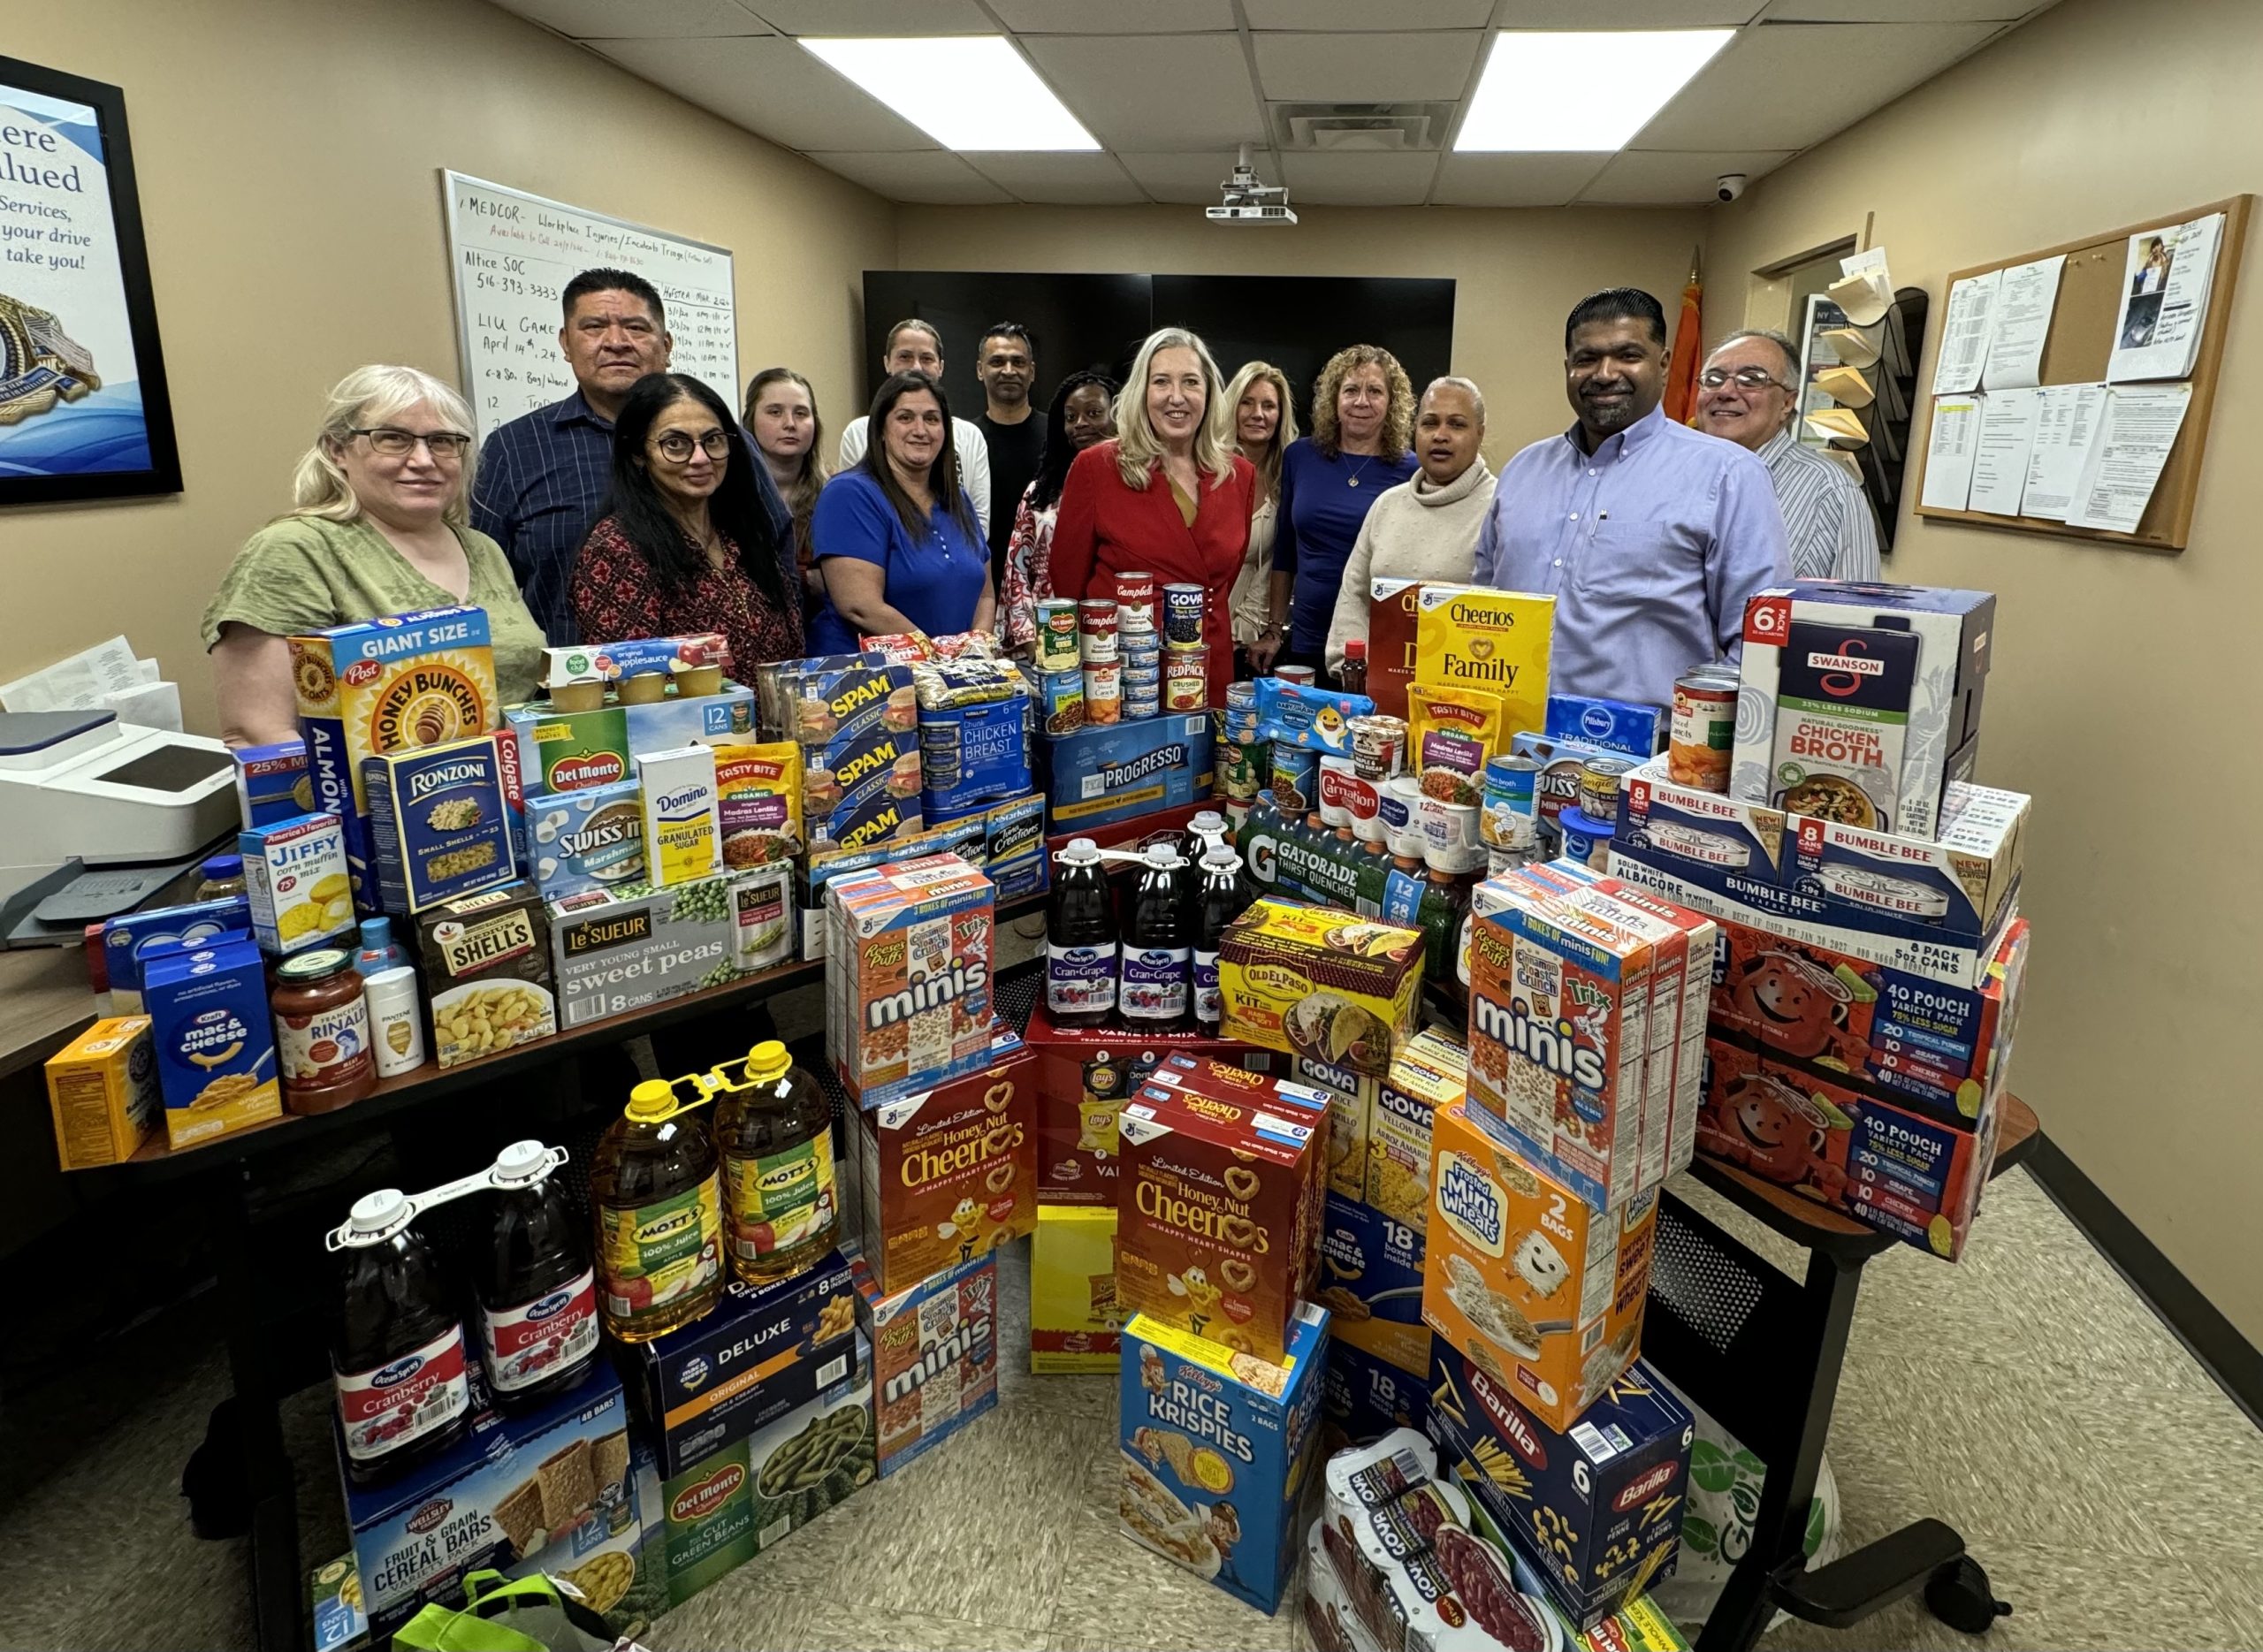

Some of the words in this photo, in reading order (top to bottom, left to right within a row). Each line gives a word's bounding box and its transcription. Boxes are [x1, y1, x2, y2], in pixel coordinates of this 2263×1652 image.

[0, 129, 57, 154] ere
[0, 153, 84, 192] lued
[2, 224, 44, 245] your
[49, 227, 92, 247] drive
[6, 247, 44, 268] take
[49, 252, 86, 270] you!
[466, 252, 497, 269] Altice
[504, 256, 525, 275] SOC
[478, 313, 507, 331] LIU
[520, 316, 555, 334] GAME
[484, 336, 508, 352] April
[1170, 593, 1202, 605] GOYA
[1451, 604, 1514, 627] Cheerios
[1754, 606, 1774, 631] 6
[1776, 608, 1787, 632] PACK
[362, 632, 423, 658] GIANT
[430, 623, 468, 644] SIZE
[617, 649, 644, 659] original
[619, 654, 668, 668] applesauce
[1812, 654, 1879, 673] SWANSON
[349, 662, 378, 683] Post
[1444, 653, 1519, 688] Family
[831, 675, 892, 719] SPAM
[379, 681, 413, 750] HONEY
[415, 673, 477, 726] BUNCHES
[708, 708, 727, 725] 12
[1431, 705, 1458, 717] TASTY
[1459, 710, 1481, 723] BITE
[1802, 701, 1819, 710] 33%
[1821, 703, 1842, 712] LESS
[1844, 706, 1878, 718] SODIUM
[709, 722, 728, 732] CANS
[964, 719, 985, 728] Chunk
[964, 724, 1017, 743] CHICKEN
[1585, 716, 1612, 728] Pillsbury
[1801, 717, 1834, 728] NATURAL
[1442, 731, 1469, 741] ORGANIC
[1558, 732, 1634, 752] TRADITIONAL
[1797, 724, 1879, 748] CHICKEN
[964, 739, 1011, 760] BREAST
[1790, 736, 1883, 768] BROTH
[251, 759, 287, 774] 25%
[501, 738, 520, 801] Colgate
[555, 769, 577, 783] Del
[581, 763, 620, 780] Monte
[717, 765, 751, 780] TASTY
[753, 765, 779, 777] BITE
[836, 742, 897, 787] SPAM
[1106, 746, 1181, 788] PROGRESSO
[411, 764, 485, 797] RONZONI
[1322, 776, 1375, 806] Carnation
[657, 787, 707, 812] Domino
[731, 790, 769, 800] ORGANIC
[1541, 800, 1559, 810] Milk
[1634, 787, 1645, 800] 8
[1658, 790, 1711, 814] BUMBLE
[1713, 803, 1738, 818] BEE
[723, 807, 751, 817] Madras
[752, 804, 779, 814] Lentils
[658, 826, 713, 845] GRANULATED
[674, 838, 699, 849] SUGAR
[1798, 840, 1823, 850] CANS
[1804, 826, 1817, 841] 8
[270, 834, 340, 867] JIFFY
[1659, 838, 1706, 857] BUMBLE
[1708, 852, 1731, 863] BEE
[276, 863, 301, 877] corn
[303, 850, 339, 870] muffin
[300, 866, 320, 879] mix
[1279, 841, 1359, 887] GATORADE
[1618, 859, 1639, 870] SOLID
[1641, 866, 1664, 878] WHITE
[1955, 859, 1987, 871] NEW!
[1278, 858, 1307, 879] THIRST
[1309, 872, 1356, 900] QUENCHER
[1617, 868, 1683, 895] ALBACORE
[1391, 901, 1409, 917] 28
[453, 925, 529, 968] SHELLS
[565, 961, 596, 975] VERY
[601, 951, 640, 966] YOUNG
[643, 940, 680, 955] SMALL
[567, 955, 654, 995] sweet
[659, 940, 723, 975] peas
[868, 956, 987, 1029] minis
[1235, 993, 1260, 1008] KIT
[1567, 978, 1613, 1012] Trix
[1887, 984, 1909, 1000] 40
[1914, 991, 1970, 1016] POUCH
[200, 1011, 225, 1022] Kraft
[1892, 1001, 1932, 1017] VARIETY
[1937, 1013, 1963, 1026] PACK
[1883, 1024, 1903, 1038] 20
[1911, 1016, 1931, 1027] LESS
[1932, 1022, 1958, 1035] SUGAR
[1475, 995, 1605, 1090] minis
[1886, 1039, 1901, 1052] 10
[1915, 1050, 1942, 1062] GRAPE
[1882, 1054, 1898, 1067] 10
[1910, 1065, 1942, 1078] CHERRY
[1089, 1114, 1114, 1126] Lay's
[1370, 1138, 1388, 1160] 3
[1859, 1151, 1878, 1168] 20
[761, 1159, 816, 1188] MOTT'S
[926, 1177, 952, 1191] HAPPY
[956, 1164, 980, 1183] HEART
[982, 1153, 1011, 1171] SHAPES
[1152, 1155, 1187, 1176] Limited
[1188, 1168, 1224, 1189] Edition
[1453, 1165, 1490, 1196] Frosted
[764, 1191, 791, 1206] 100%
[793, 1180, 815, 1197] Juice
[783, 1199, 801, 1210] APPLE
[1178, 1182, 1219, 1211] Honey
[1224, 1197, 1250, 1218] Nut
[1446, 1174, 1498, 1223] Mini
[1443, 1193, 1500, 1246] Wheats
[1549, 1194, 1566, 1222] 2
[1382, 1222, 1413, 1250] 18
[1541, 1214, 1574, 1242] BAGS
[1383, 1252, 1412, 1269] inside
[1384, 1242, 1412, 1260] boxes
[518, 1307, 584, 1346] Cranberry
[718, 1318, 791, 1366] DELUXE
[709, 1369, 760, 1403] ORIGINAL
[1178, 1365, 1223, 1392] Kellogg's
[1171, 1381, 1231, 1427] RICE
[1150, 1395, 1253, 1462] KRISPIES
[1251, 1414, 1257, 1423] 2
[1258, 1418, 1279, 1431] BAGS
[1681, 1424, 1693, 1446] 6
[1619, 1468, 1671, 1508] Barilla
[385, 1542, 421, 1568] FRUIT
[425, 1534, 437, 1548] &
[441, 1510, 478, 1539] GRAIN
[703, 1517, 728, 1538] CUT
[374, 1545, 442, 1591] CEREAL
[446, 1514, 492, 1552] BARS
